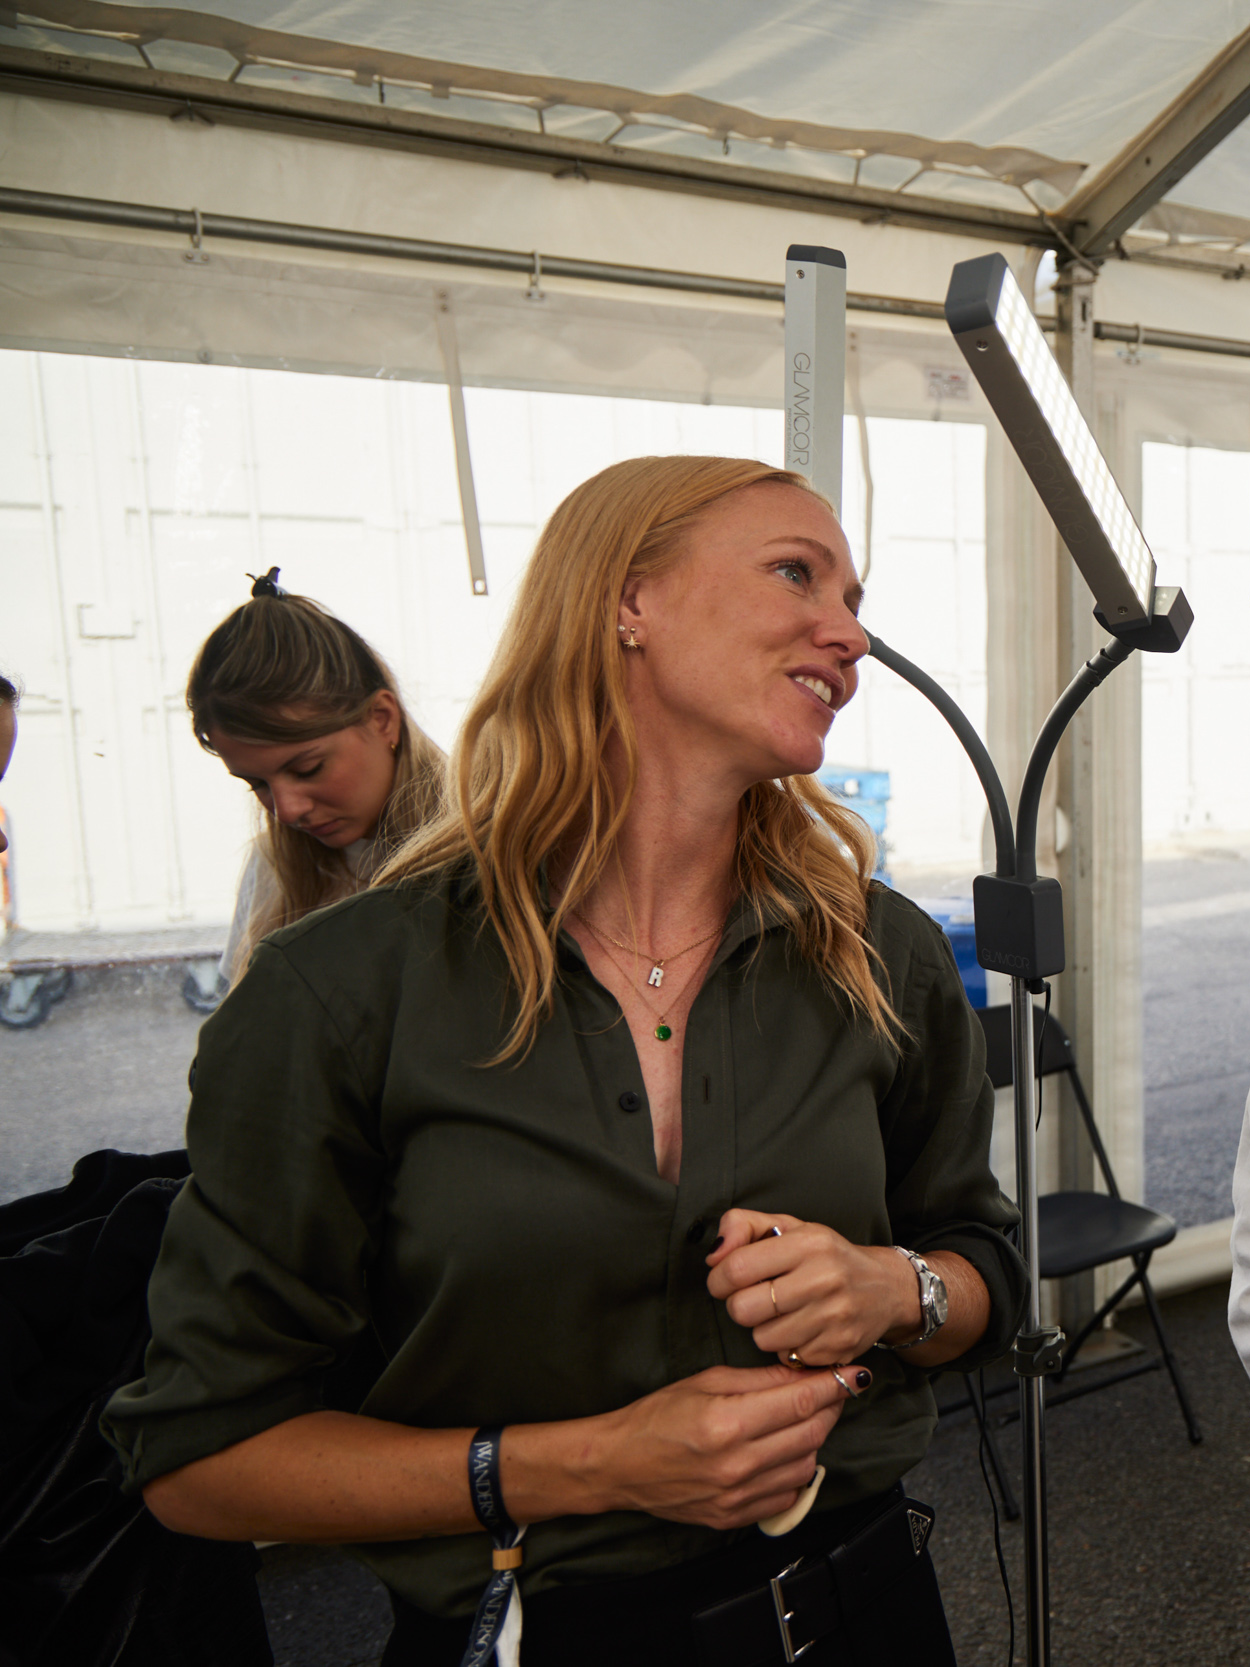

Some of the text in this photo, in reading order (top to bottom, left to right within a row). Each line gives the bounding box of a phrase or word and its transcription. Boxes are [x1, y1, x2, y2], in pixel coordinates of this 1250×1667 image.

[793, 352, 811, 466] GLAMCOR
[981, 947, 1030, 970] GLAMCOR
[648, 967, 663, 987] R
